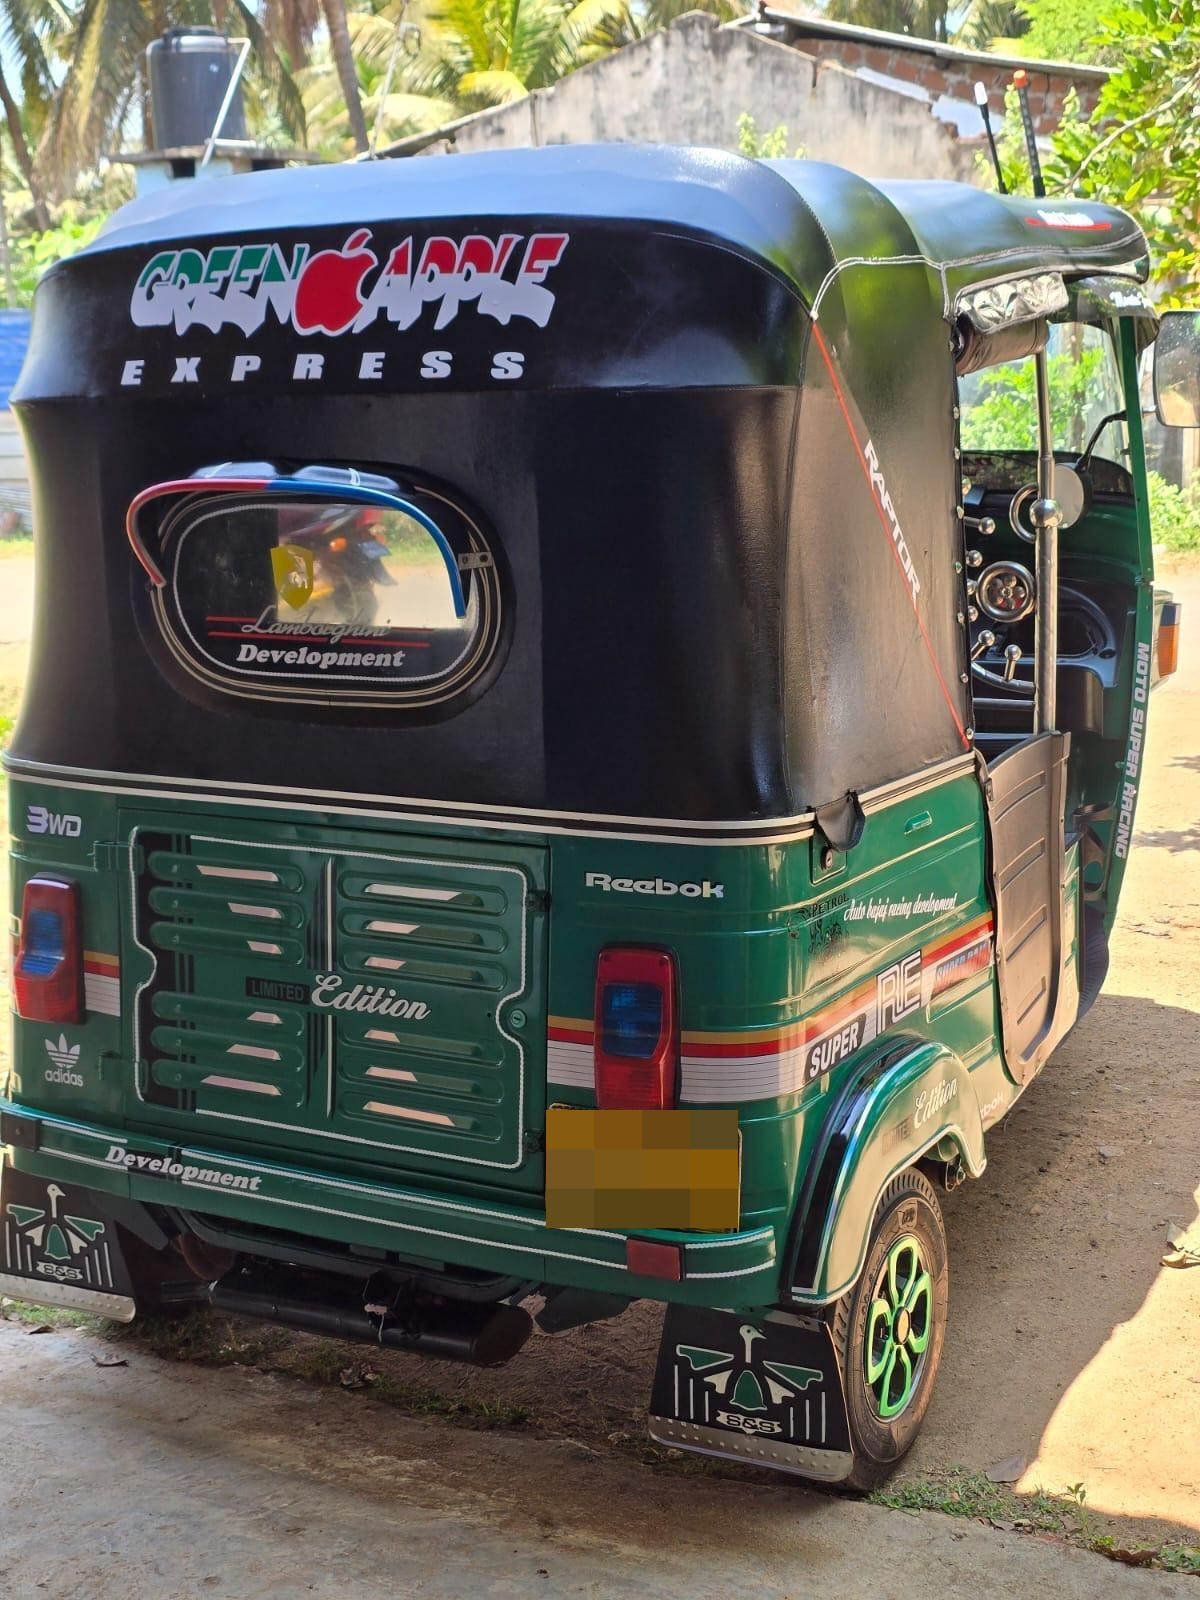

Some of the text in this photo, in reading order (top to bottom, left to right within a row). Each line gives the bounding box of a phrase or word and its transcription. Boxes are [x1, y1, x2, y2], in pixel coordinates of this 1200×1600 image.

[130, 233, 569, 338] GREEN APPLE
[120, 351, 525, 386] EXPRESS
[864, 440, 921, 610] RAPTOR
[241, 605, 392, 644] Lamborghini
[236, 644, 406, 669] Development
[1116, 642, 1150, 860] MOTO SUPER RACING
[26, 805, 82, 838] 3WD
[585, 872, 725, 899] Reebok
[812, 893, 850, 916] PETROL
[843, 899, 866, 921] Auto
[912, 892, 959, 916] development
[251, 974, 431, 1020] LIMITED Edition
[809, 1021, 859, 1078] SUPER
[877, 950, 921, 1035] RE
[45, 1068, 83, 1087] adidas
[914, 1079, 957, 1129] Edition
[105, 1145, 262, 1191] Development
[43, 1263, 80, 1280] S&S
[725, 1413, 777, 1434] S&S
